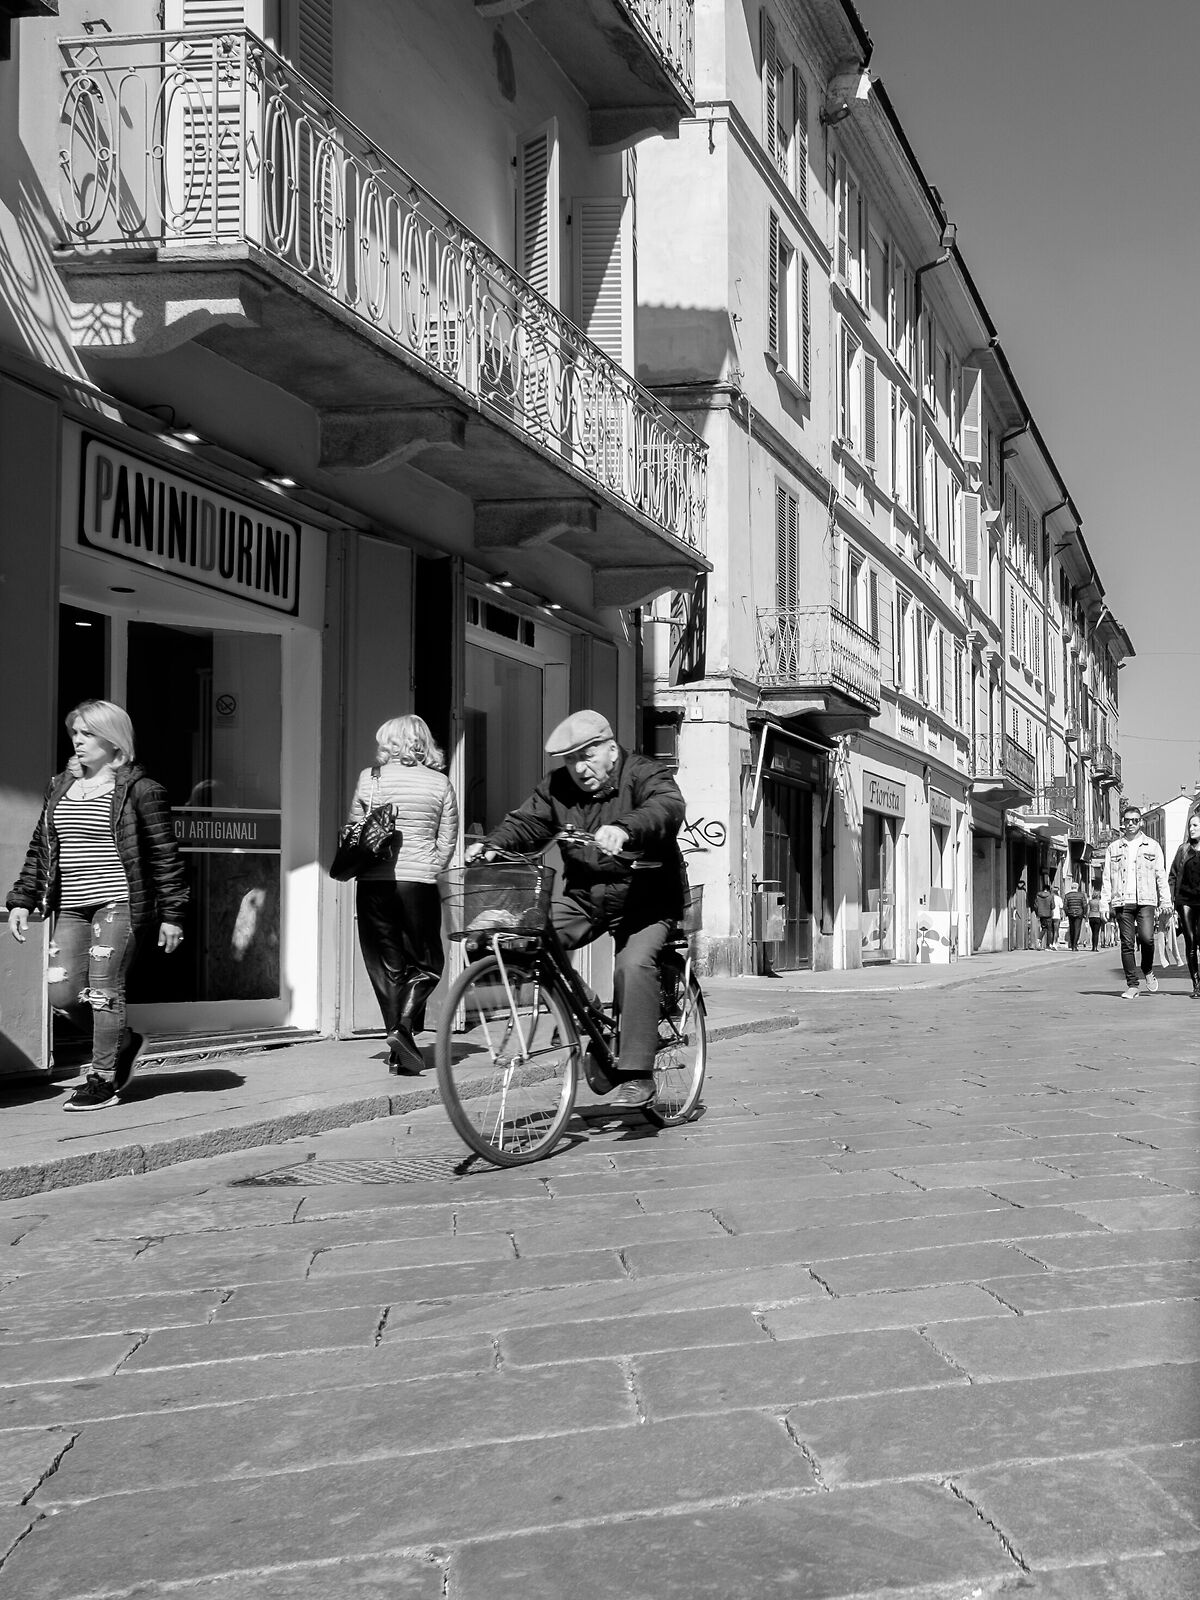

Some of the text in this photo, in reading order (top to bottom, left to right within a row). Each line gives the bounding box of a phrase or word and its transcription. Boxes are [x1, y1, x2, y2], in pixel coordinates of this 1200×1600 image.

[869, 780, 899, 811] Fiorista
[174, 820, 257, 840] CI ARTIGIANALI
